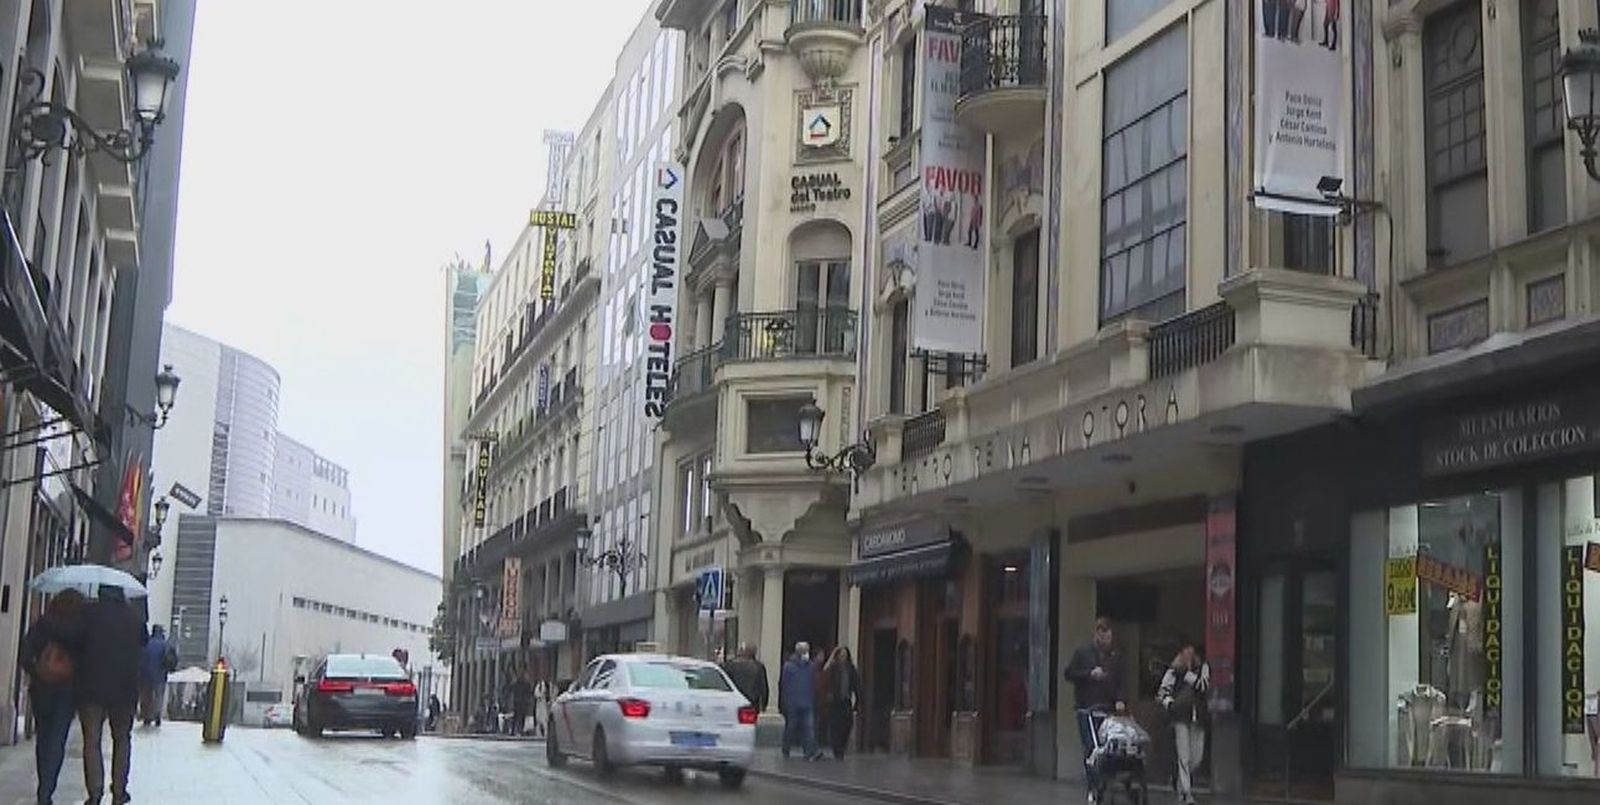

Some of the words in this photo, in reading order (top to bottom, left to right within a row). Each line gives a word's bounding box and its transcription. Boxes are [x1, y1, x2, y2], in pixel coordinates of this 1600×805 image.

[791, 173, 842, 190] CASUAL
[925, 166, 982, 196] FAVOR
[530, 211, 575, 227] HOSTAL
[652, 198, 678, 296] CASUAL
[645, 305, 673, 418] HOTELES
[1459, 402, 1561, 435] MUESTRARIOS
[974, 434, 1031, 479] RENA
[1437, 444, 1478, 466] STOCK
[1484, 441, 1500, 459] DE
[1486, 546, 1500, 705] LIQUIDACION
[1565, 550, 1583, 718] LIQUIDACION
